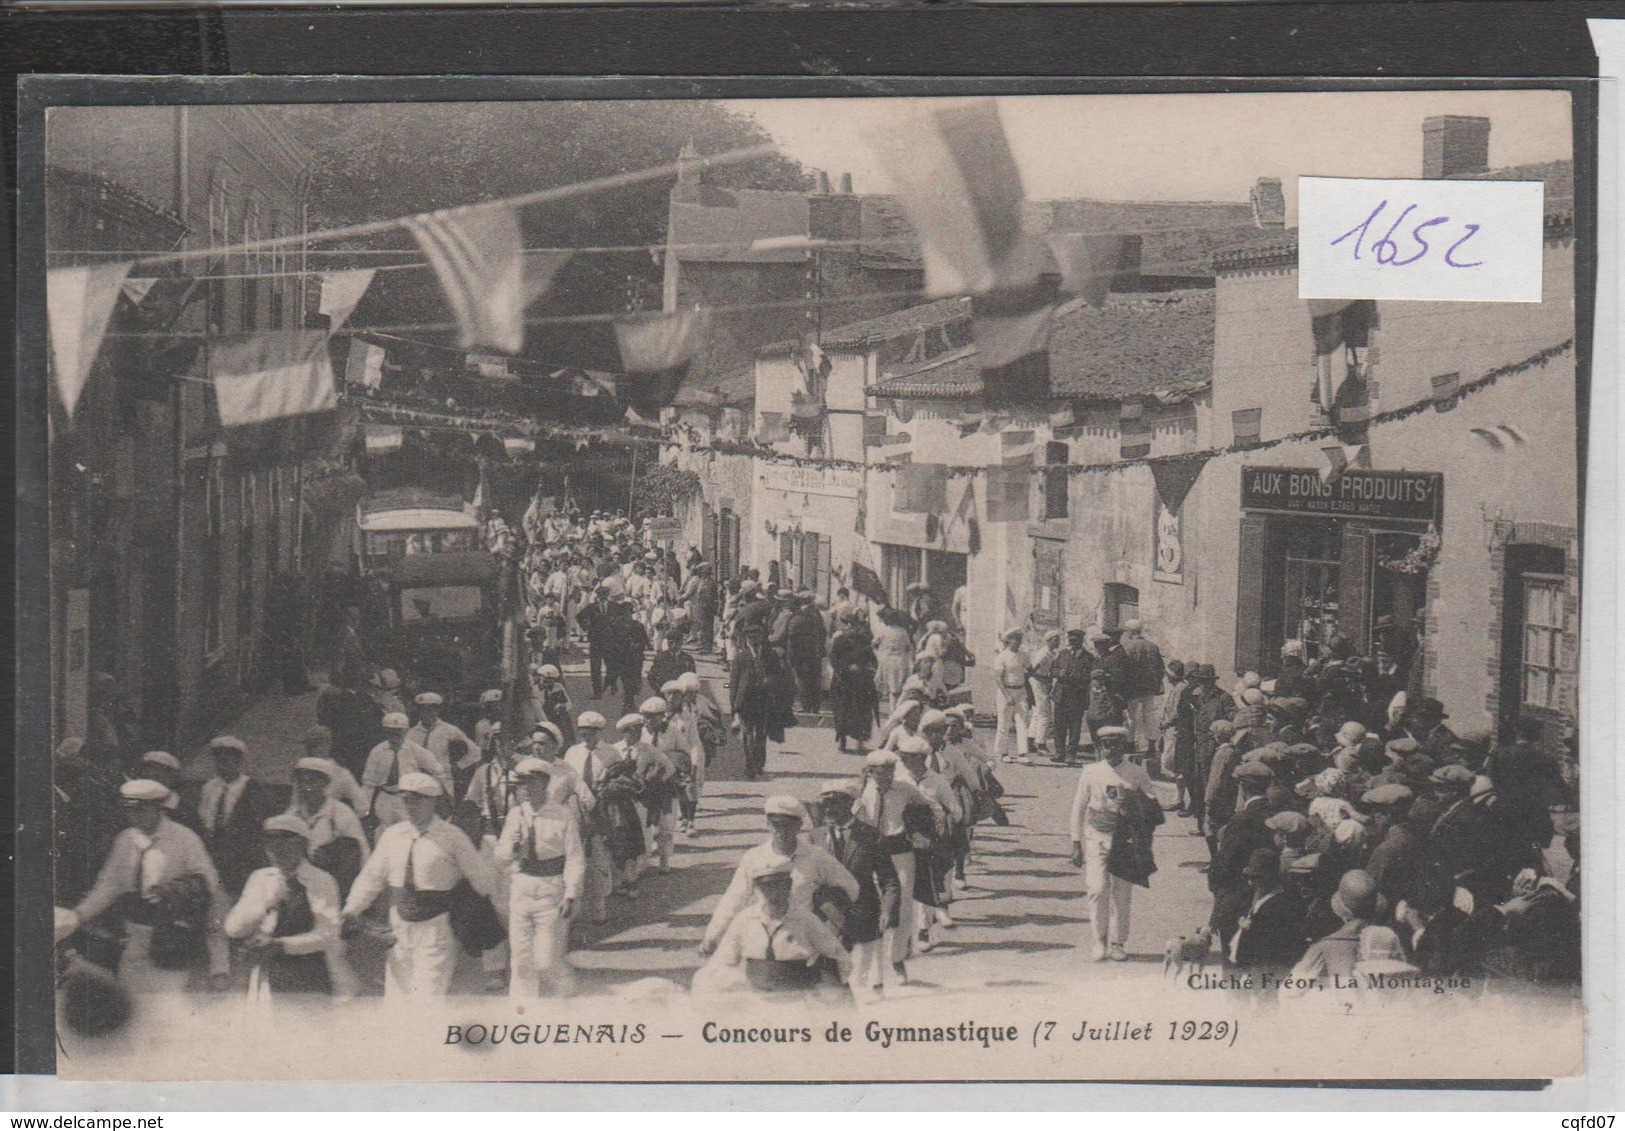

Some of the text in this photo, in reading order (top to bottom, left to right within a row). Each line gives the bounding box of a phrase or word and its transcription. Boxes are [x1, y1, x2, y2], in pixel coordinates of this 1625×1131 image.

[1330, 199, 1483, 267] 1652
[1252, 473, 1426, 502] AUX BONS PRODUITS
